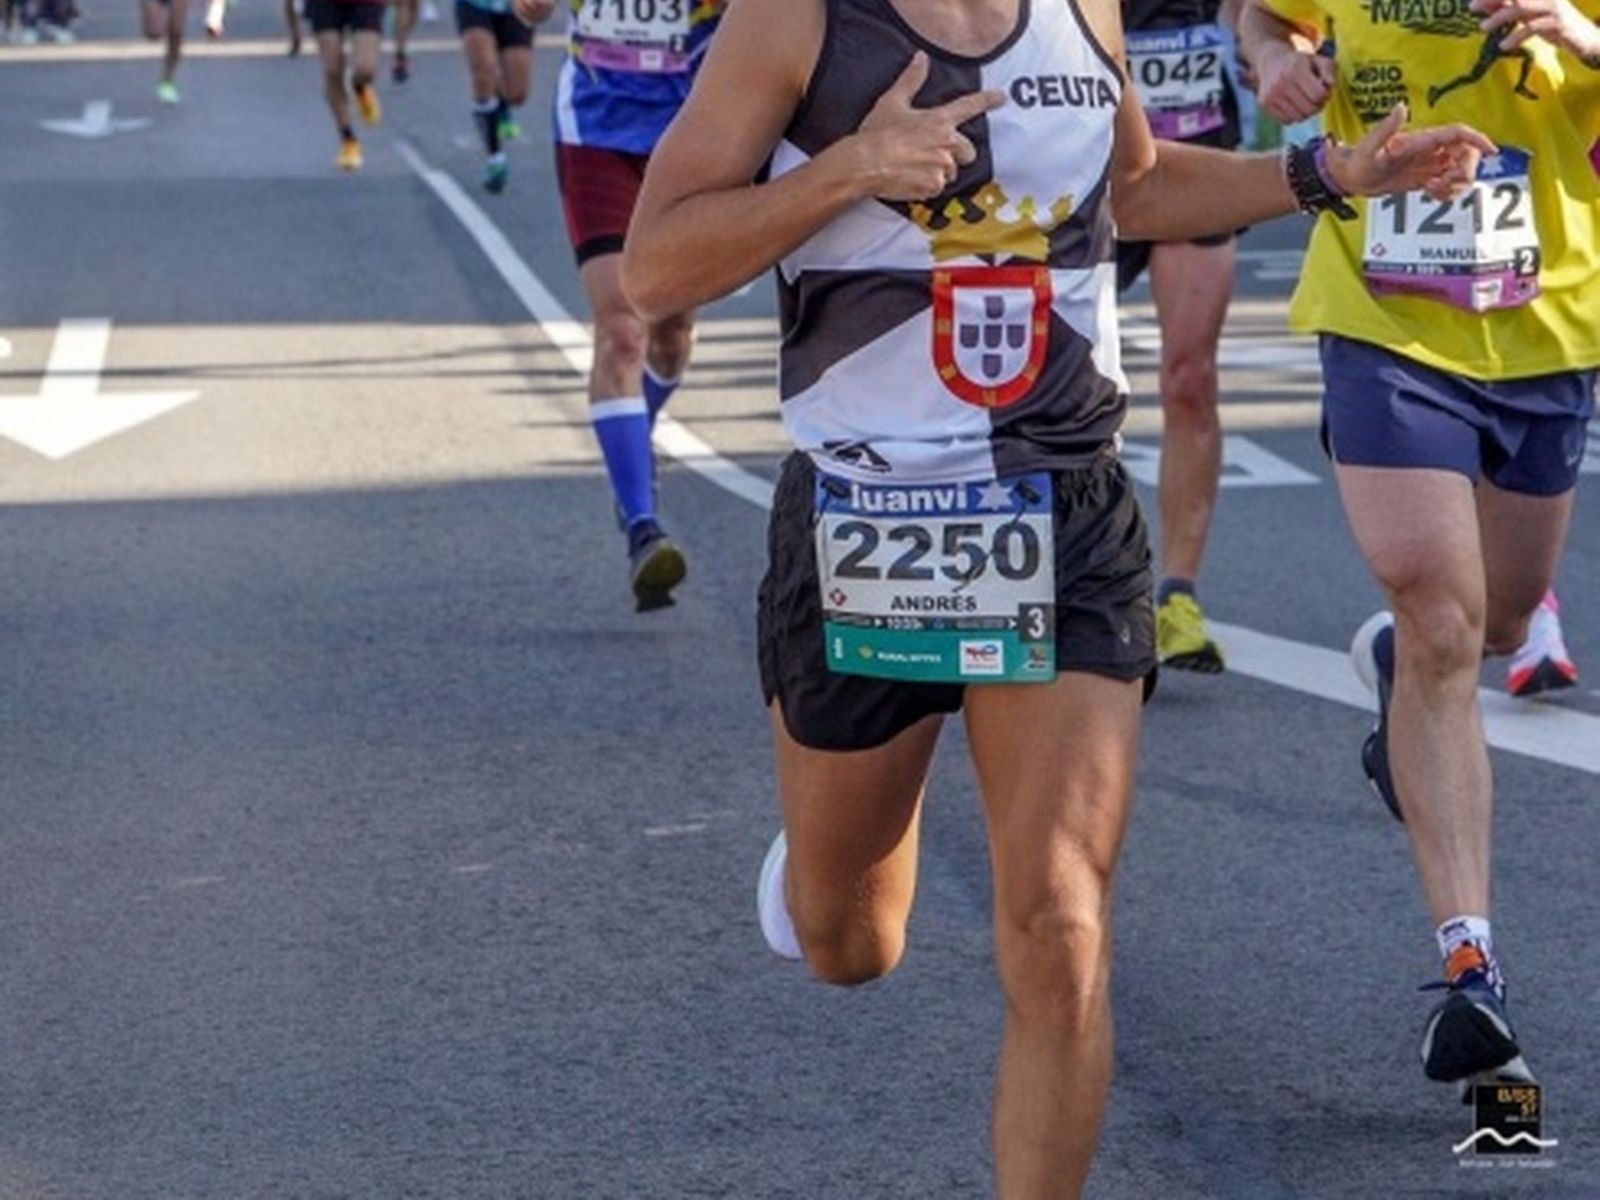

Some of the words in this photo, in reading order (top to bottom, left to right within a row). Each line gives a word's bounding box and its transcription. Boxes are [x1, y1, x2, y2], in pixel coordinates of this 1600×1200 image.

[1126, 53, 1216, 87] 042
[1010, 76, 1117, 108] CEUTA
[1381, 182, 1524, 235] 1212
[1520, 249, 1535, 274] 2
[852, 483, 968, 511] luanvi
[833, 521, 1040, 581] 2250
[1027, 608, 1045, 639] 3
